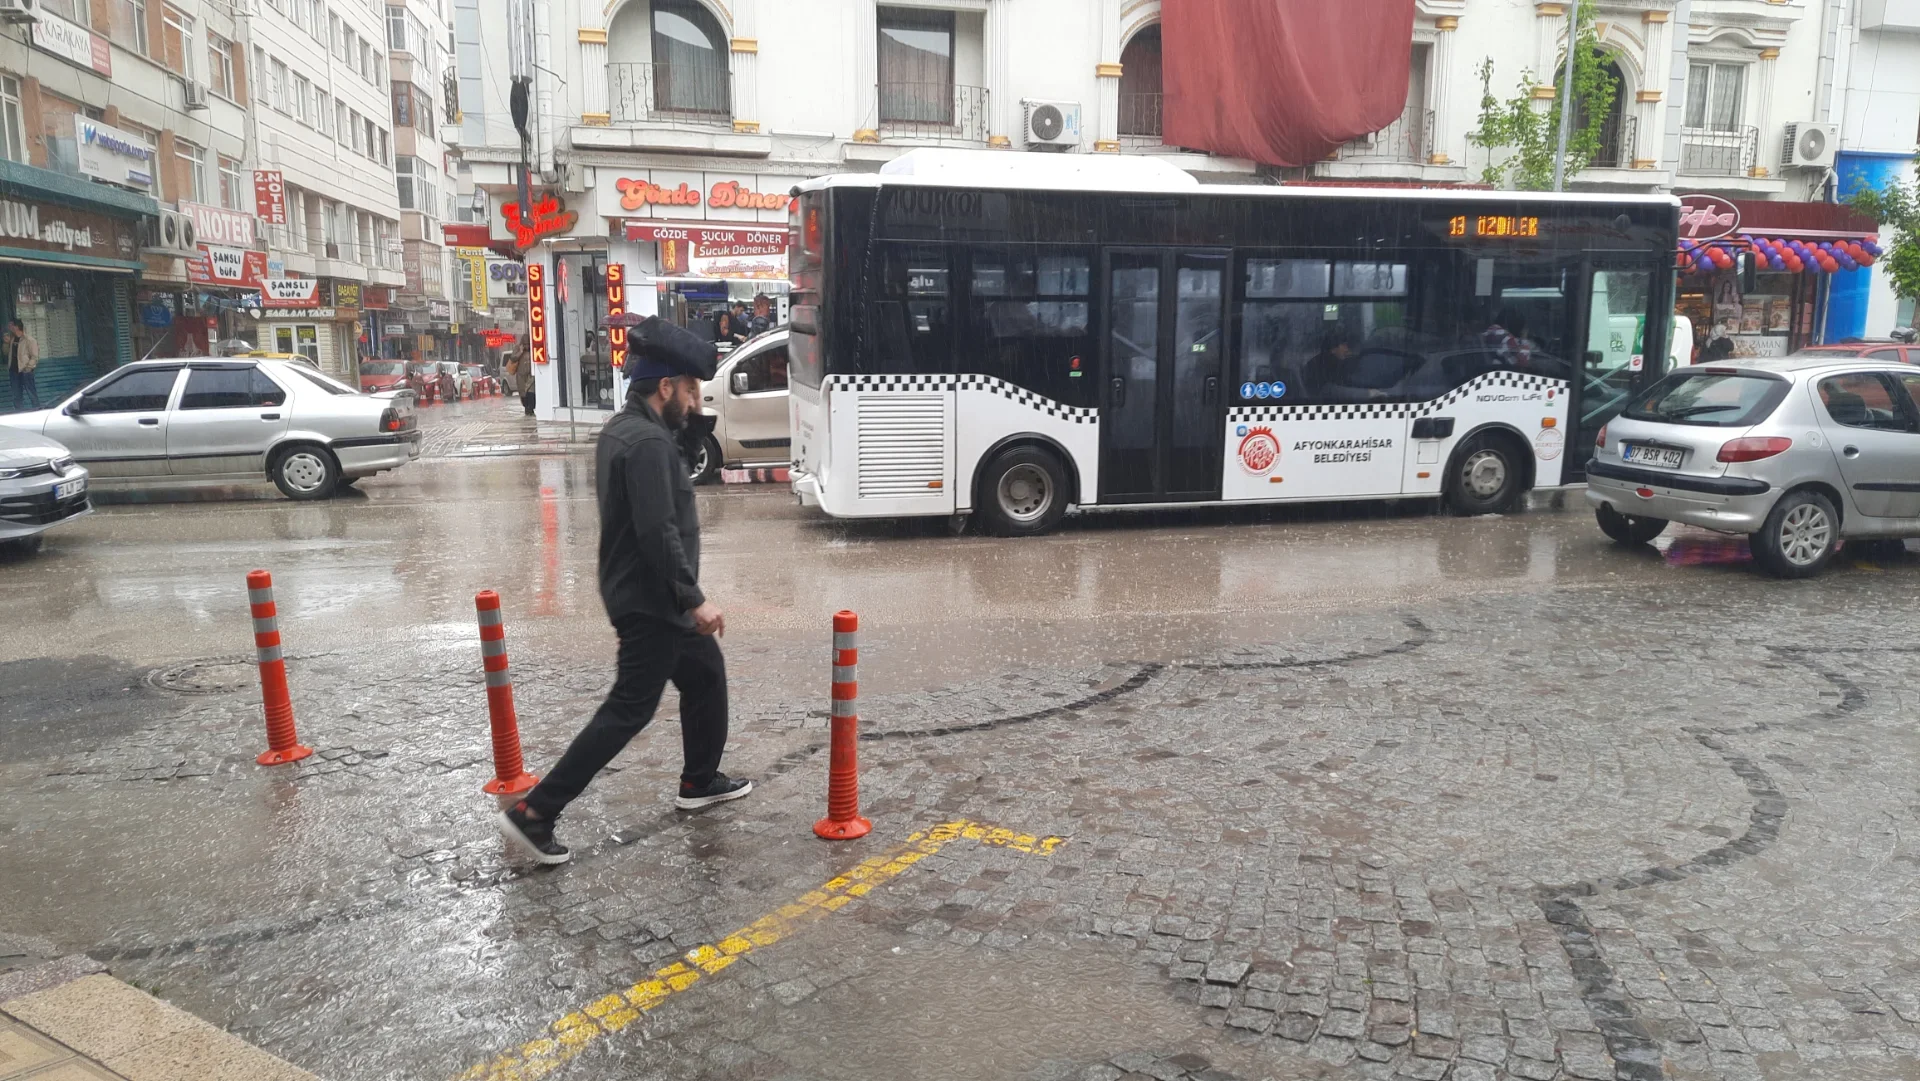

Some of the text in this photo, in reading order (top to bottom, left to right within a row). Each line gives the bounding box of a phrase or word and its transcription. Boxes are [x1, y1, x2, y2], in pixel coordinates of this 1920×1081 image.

[267, 172, 284, 223] NOTER
[616, 177, 700, 211] Gözde
[708, 180, 790, 211] Döner
[1449, 215, 1538, 236] 13 ÖZDİLEK
[45, 220, 92, 251] atölyesi
[653, 228, 782, 244] GÖZDE SUCUK DÖNER
[213, 251, 241, 265] ŞANSLI
[699, 246, 730, 257] Sucuk
[271, 281, 309, 290] ŞANSLI
[265, 308, 307, 318] SAĞLAM
[529, 266, 545, 362] SUCUK
[1293, 436, 1393, 451] AFYONKARAHİSAR
[1313, 450, 1372, 464] BELEDİYESİ
[1630, 446, 1641, 458] 07
[1643, 449, 1660, 461] BSR
[1662, 451, 1681, 464] 402
